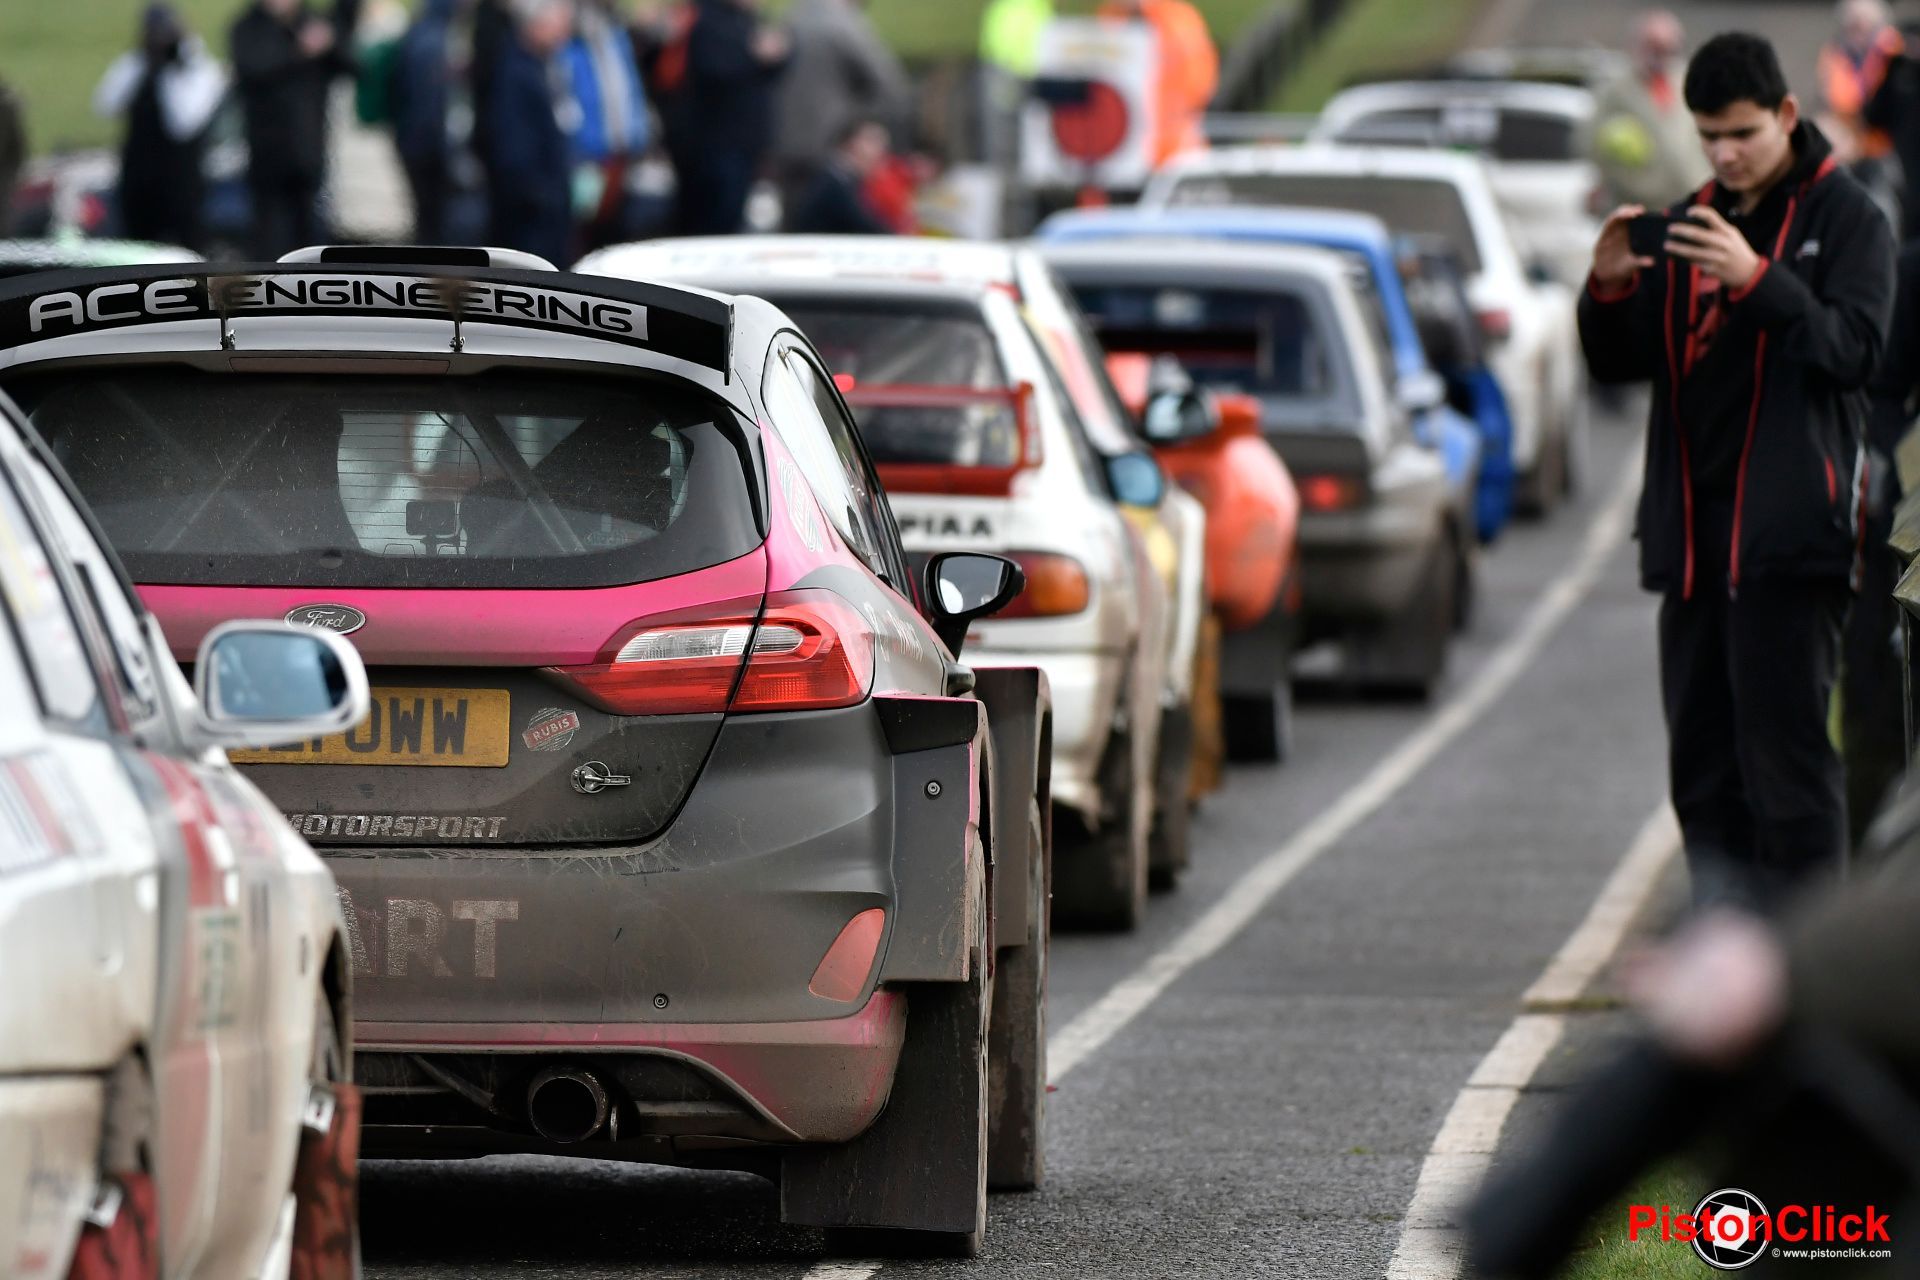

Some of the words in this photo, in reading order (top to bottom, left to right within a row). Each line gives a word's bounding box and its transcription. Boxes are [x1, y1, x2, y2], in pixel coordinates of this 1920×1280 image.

[29, 278, 199, 332] ACE
[221, 279, 633, 333] ENGINEERING
[899, 514, 992, 535] PIAA
[303, 610, 346, 628] Ford
